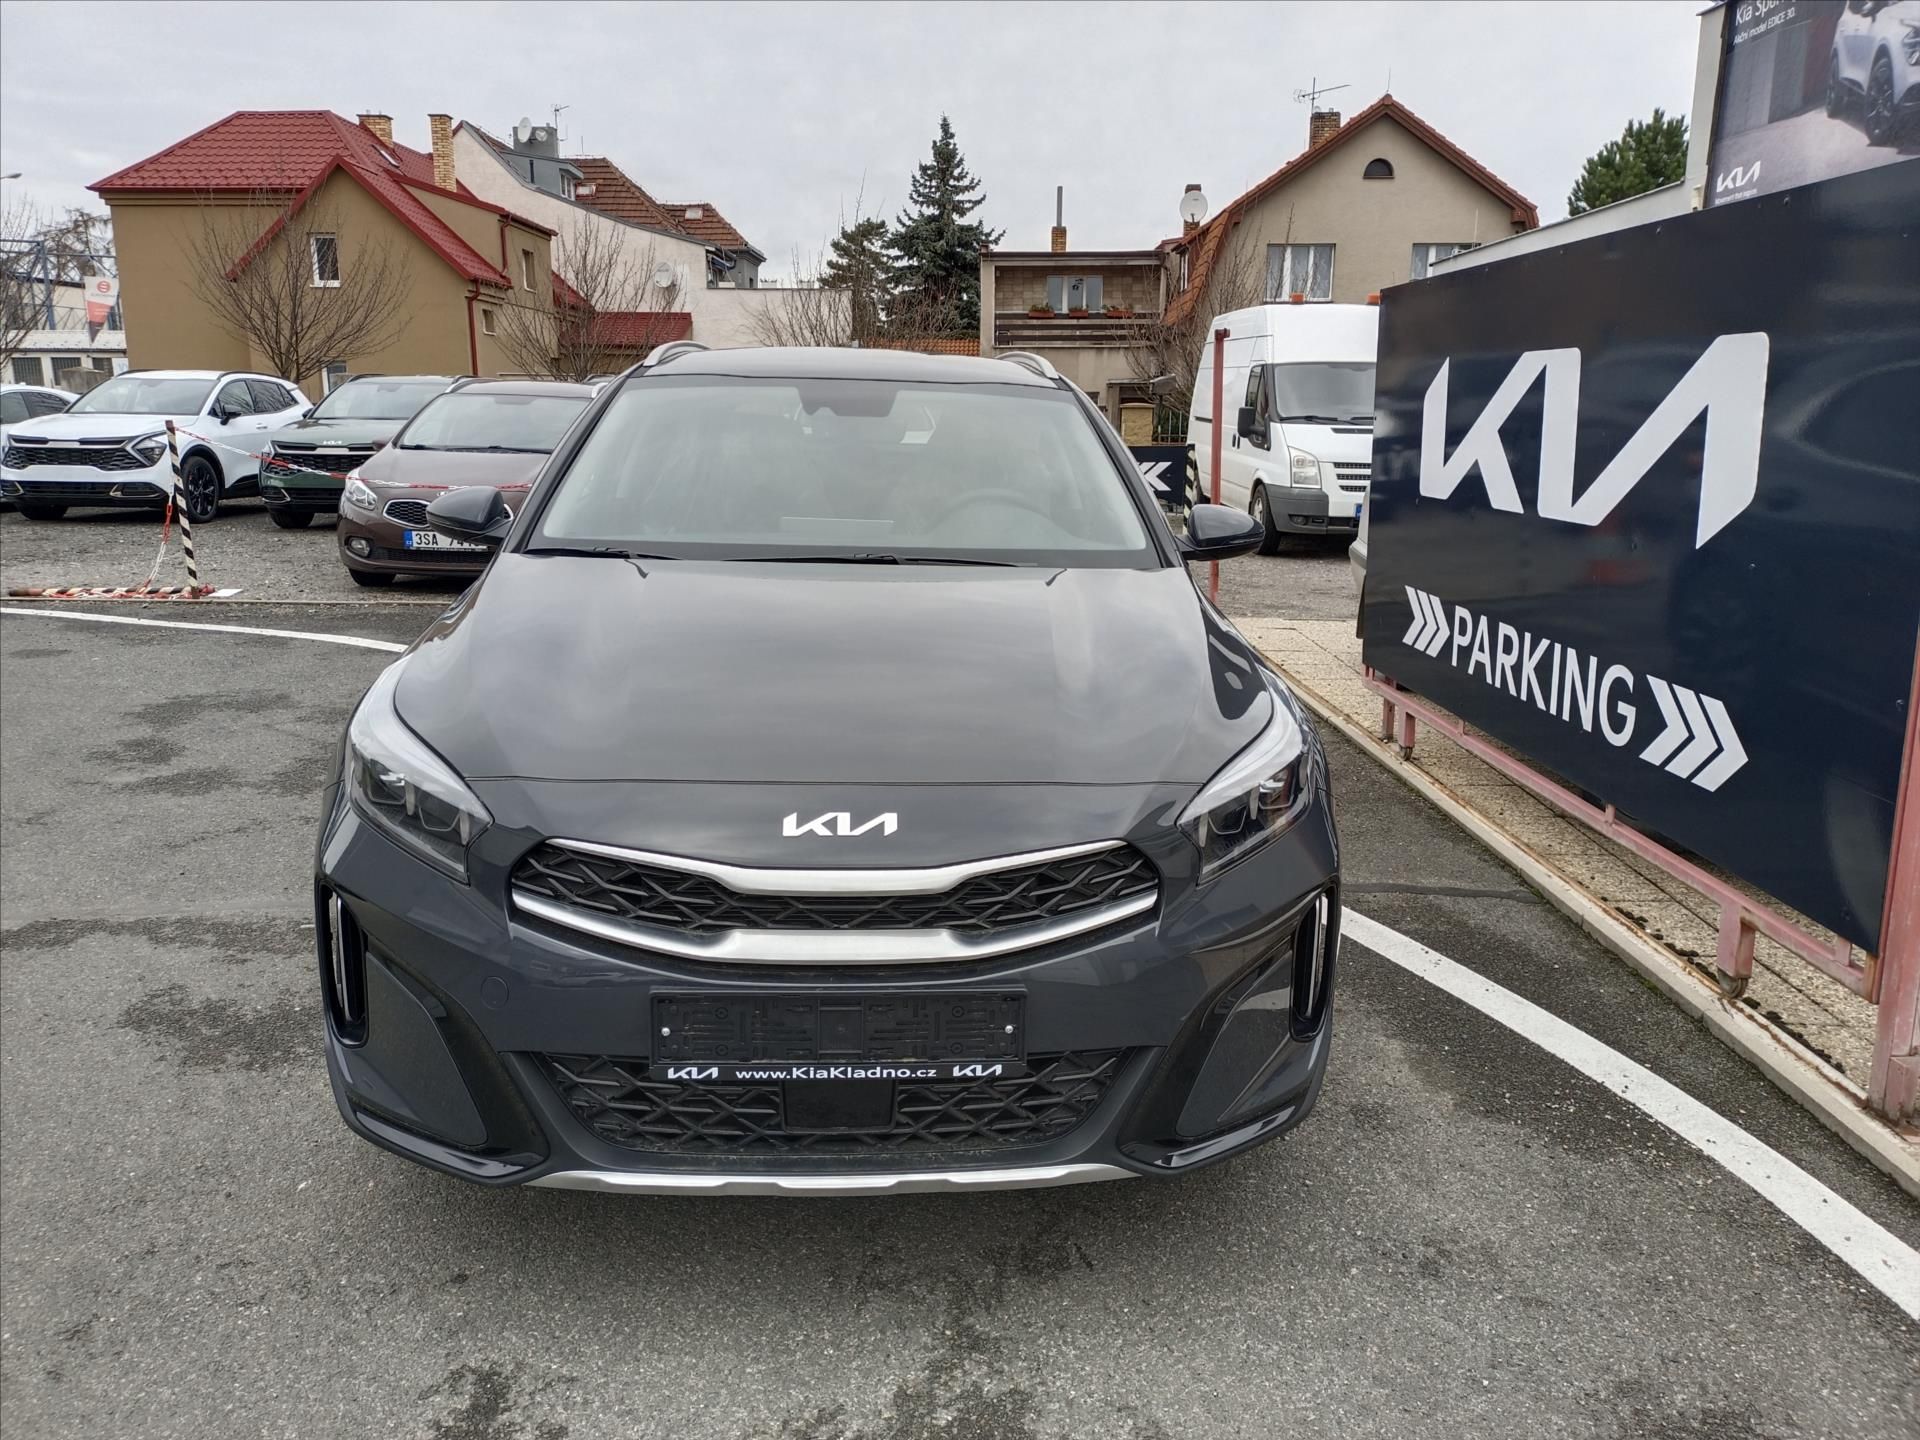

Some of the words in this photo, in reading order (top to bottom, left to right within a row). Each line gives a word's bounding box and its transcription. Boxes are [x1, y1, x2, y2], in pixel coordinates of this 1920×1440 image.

[1735, 6, 1753, 26] Kia
[1749, 21, 1767, 37] model
[1767, 11, 1786, 29] EDICE
[1716, 160, 1761, 192] KIA
[1419, 331, 1770, 549] KIA
[415, 533, 439, 546] 3SA
[1451, 605, 1637, 747] PARKING
[782, 811, 898, 836] KIA
[667, 1066, 719, 1079] KIA
[735, 1066, 937, 1079] www.KiaKladno.cz
[953, 1064, 1002, 1077] KIA
